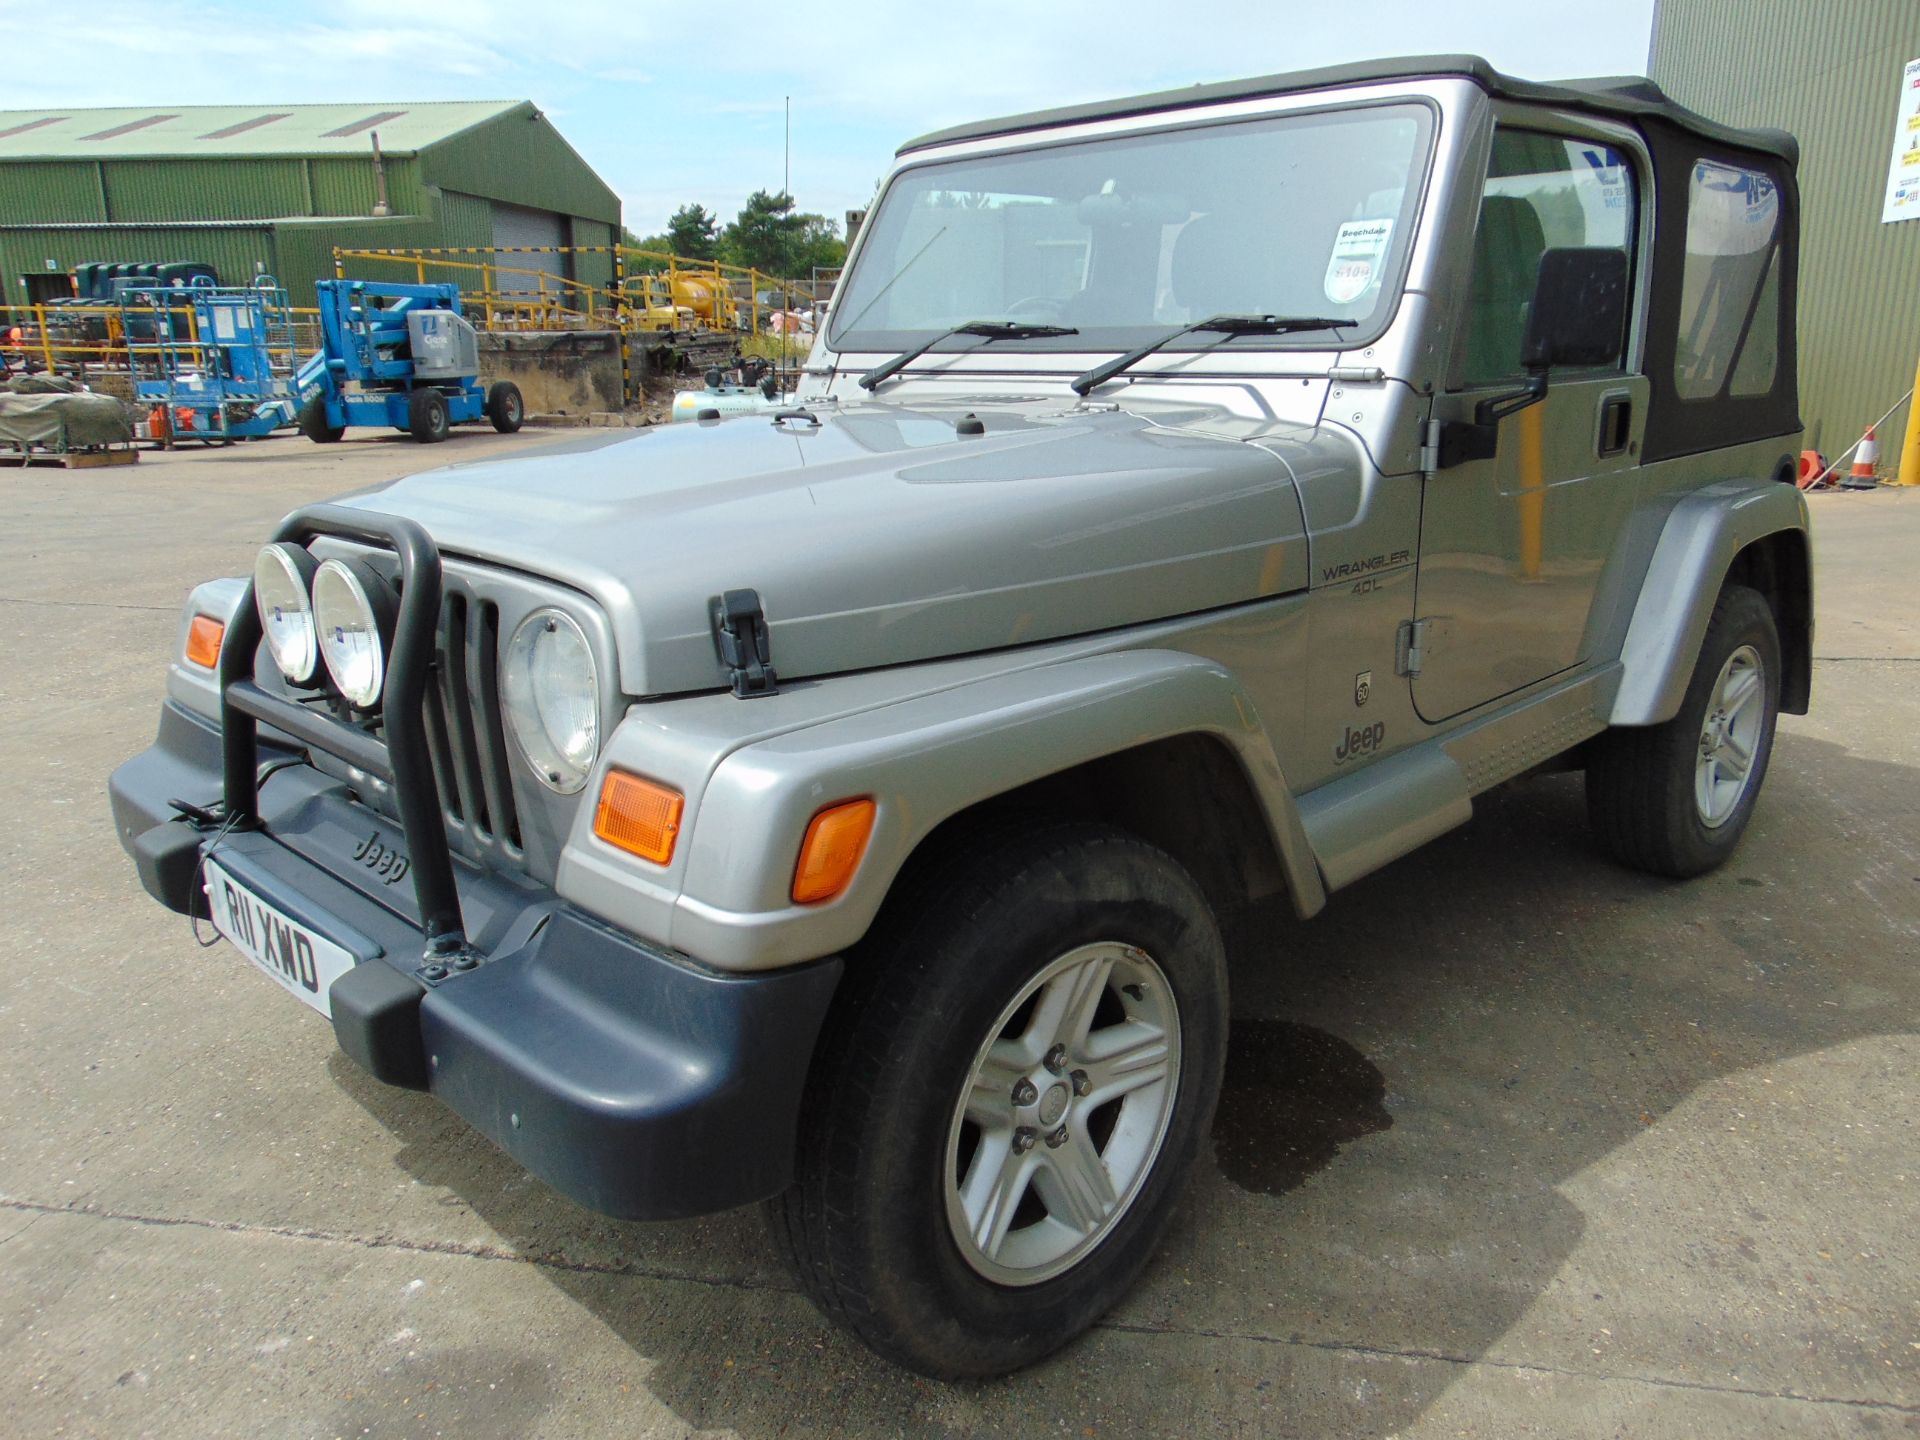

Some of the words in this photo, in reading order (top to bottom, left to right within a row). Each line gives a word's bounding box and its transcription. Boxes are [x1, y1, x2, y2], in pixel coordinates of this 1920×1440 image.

[1341, 227, 1386, 238] Beechdale
[1322, 549, 1409, 581] WRANGLER
[1357, 685, 1368, 701] 60
[1336, 720, 1385, 760] Jeep
[352, 830, 412, 886] Jeep
[256, 905, 320, 994] XWD
